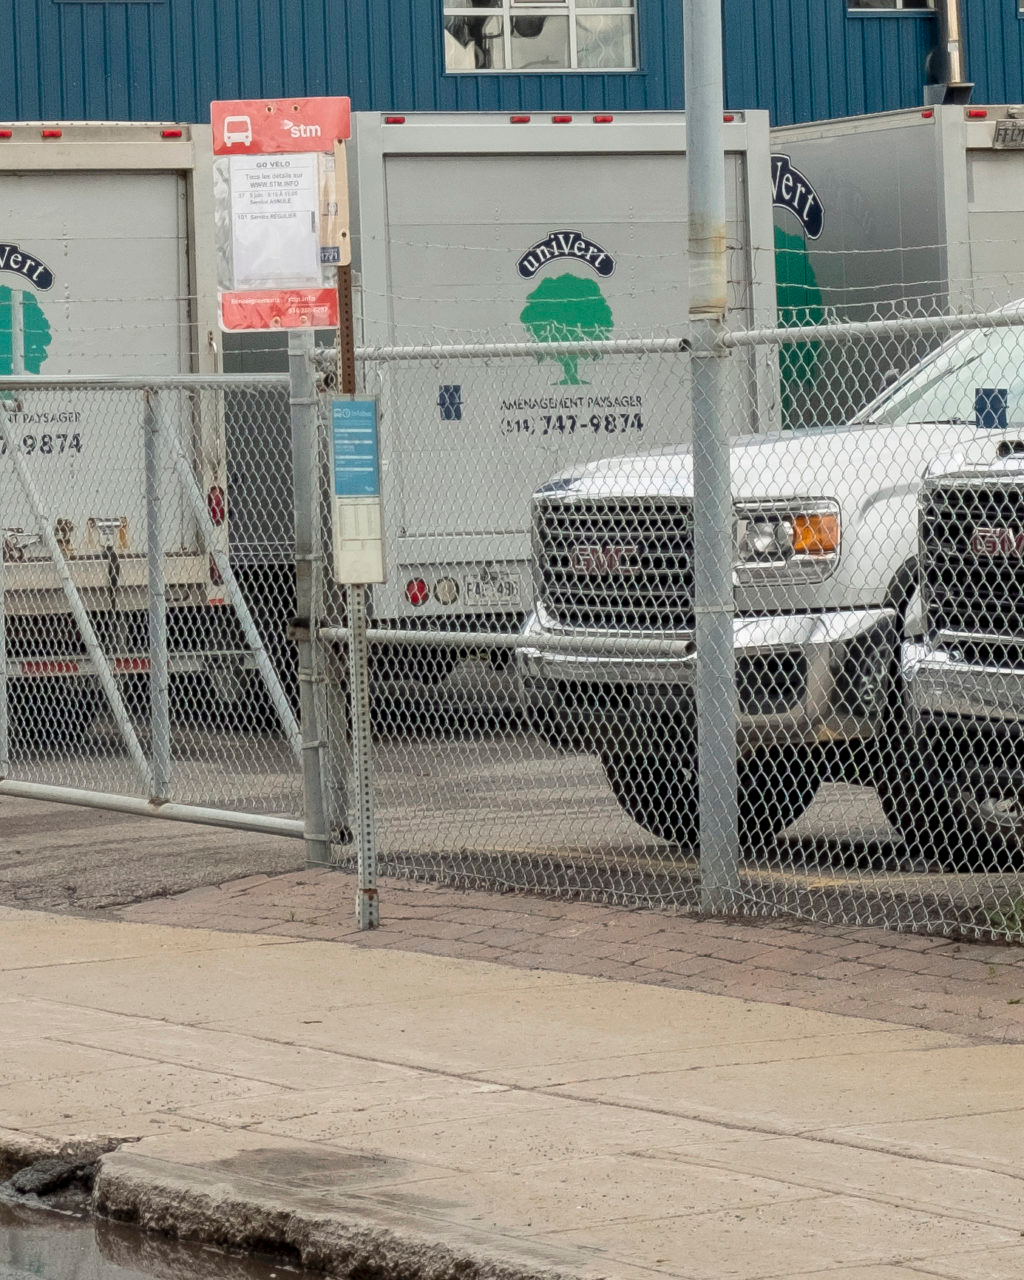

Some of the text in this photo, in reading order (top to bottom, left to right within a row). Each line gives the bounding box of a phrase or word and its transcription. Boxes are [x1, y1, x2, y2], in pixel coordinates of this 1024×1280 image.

[290, 123, 321, 137] stm
[523, 233, 608, 272] uniVert
[572, 546, 638, 575] GMC
